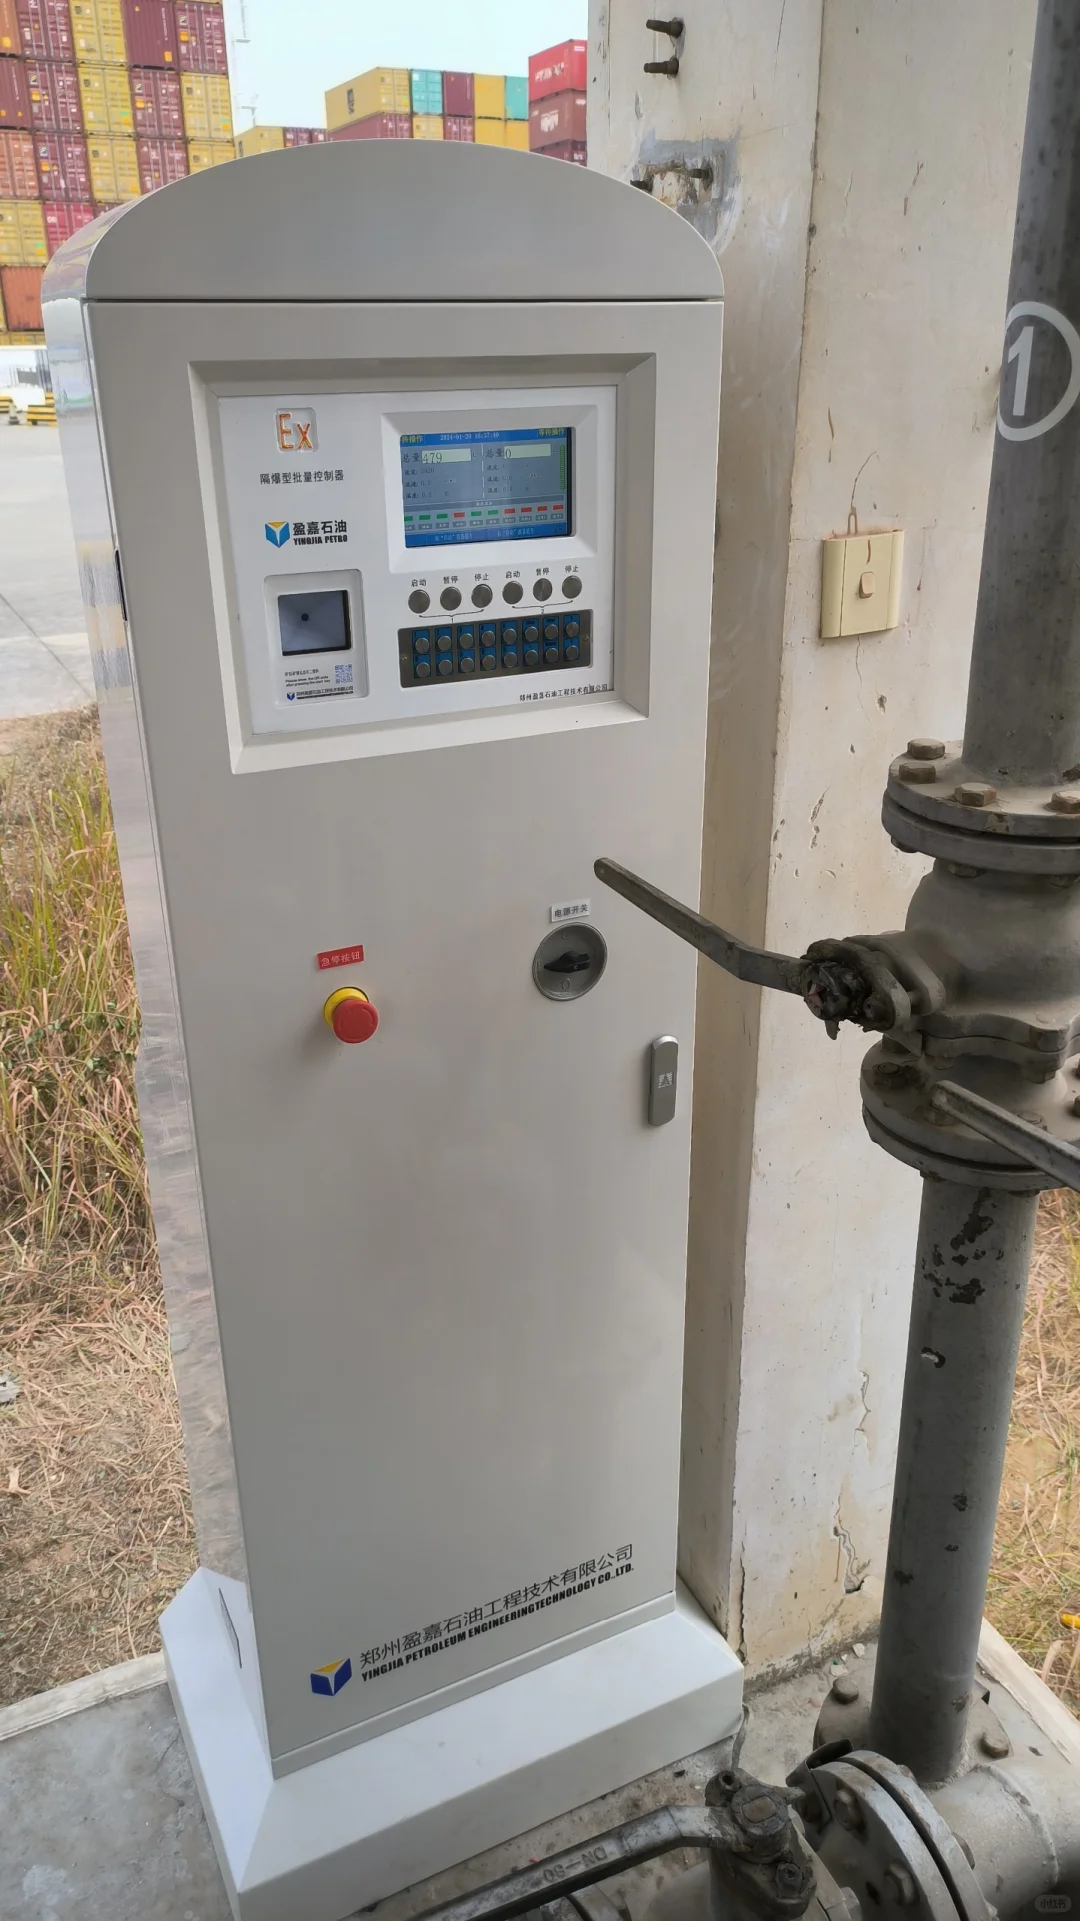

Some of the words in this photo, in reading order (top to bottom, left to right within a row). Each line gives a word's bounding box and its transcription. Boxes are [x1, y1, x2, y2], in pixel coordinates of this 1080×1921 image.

[278, 413, 313, 450] Ex
[422, 451, 442, 464] 479
[505, 448, 512, 459] 0
[260, 469, 344, 485] 隔爆型批量控制器
[292, 519, 347, 536] 盈嘉石油
[292, 536, 323, 546] YINGJIA
[324, 534, 348, 544] PETRO
[505, 570, 520, 579] 启动
[535, 567, 550, 576] 暂停
[564, 565, 579, 573] 停止
[411, 579, 427, 587] 启动
[443, 575, 459, 584] 暂停
[474, 573, 490, 581] 停止
[554, 903, 588, 917] 电源开关
[321, 951, 360, 967] 急停按钮
[359, 1544, 633, 1669] 郑州盈嘉石油工程技术有限公司
[361, 1657, 404, 1682] YINGJIA
[405, 1631, 467, 1664] PETROLEUM
